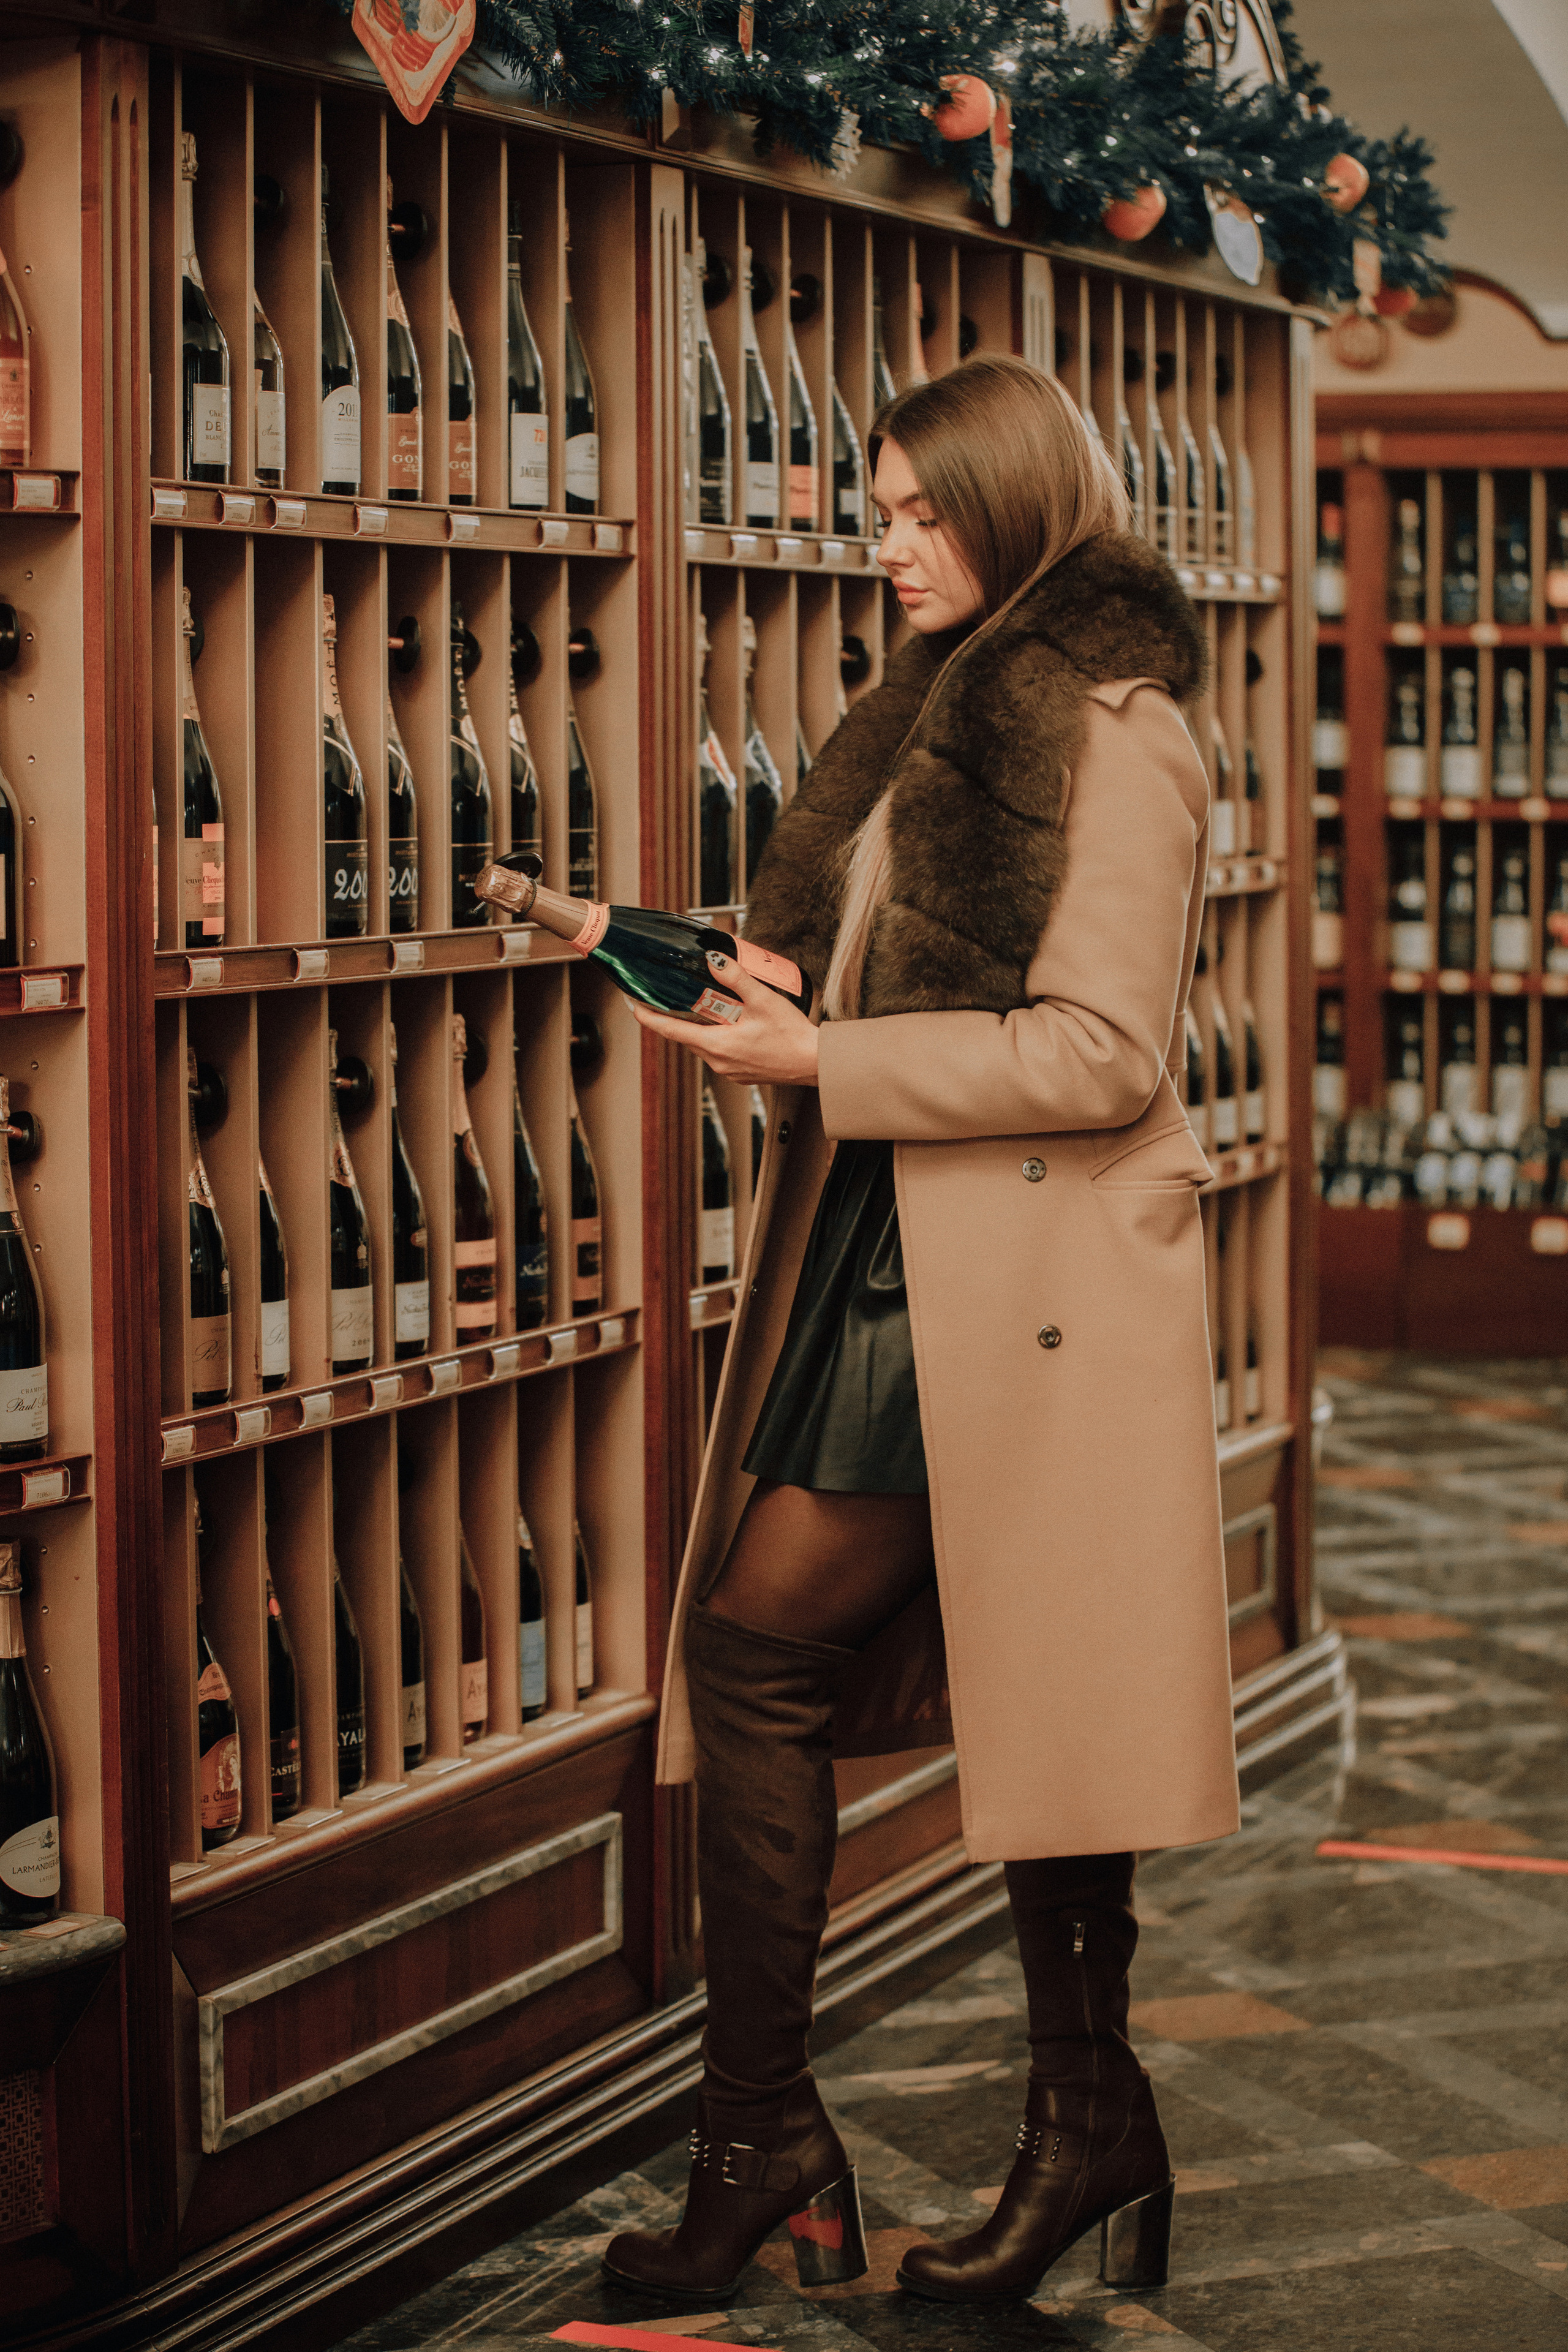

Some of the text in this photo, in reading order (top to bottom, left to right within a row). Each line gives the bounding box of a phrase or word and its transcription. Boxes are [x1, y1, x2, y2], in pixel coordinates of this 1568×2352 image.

[581, 910, 601, 944] Veuve Clicquot
[6, 1397, 37, 1413] Paul
